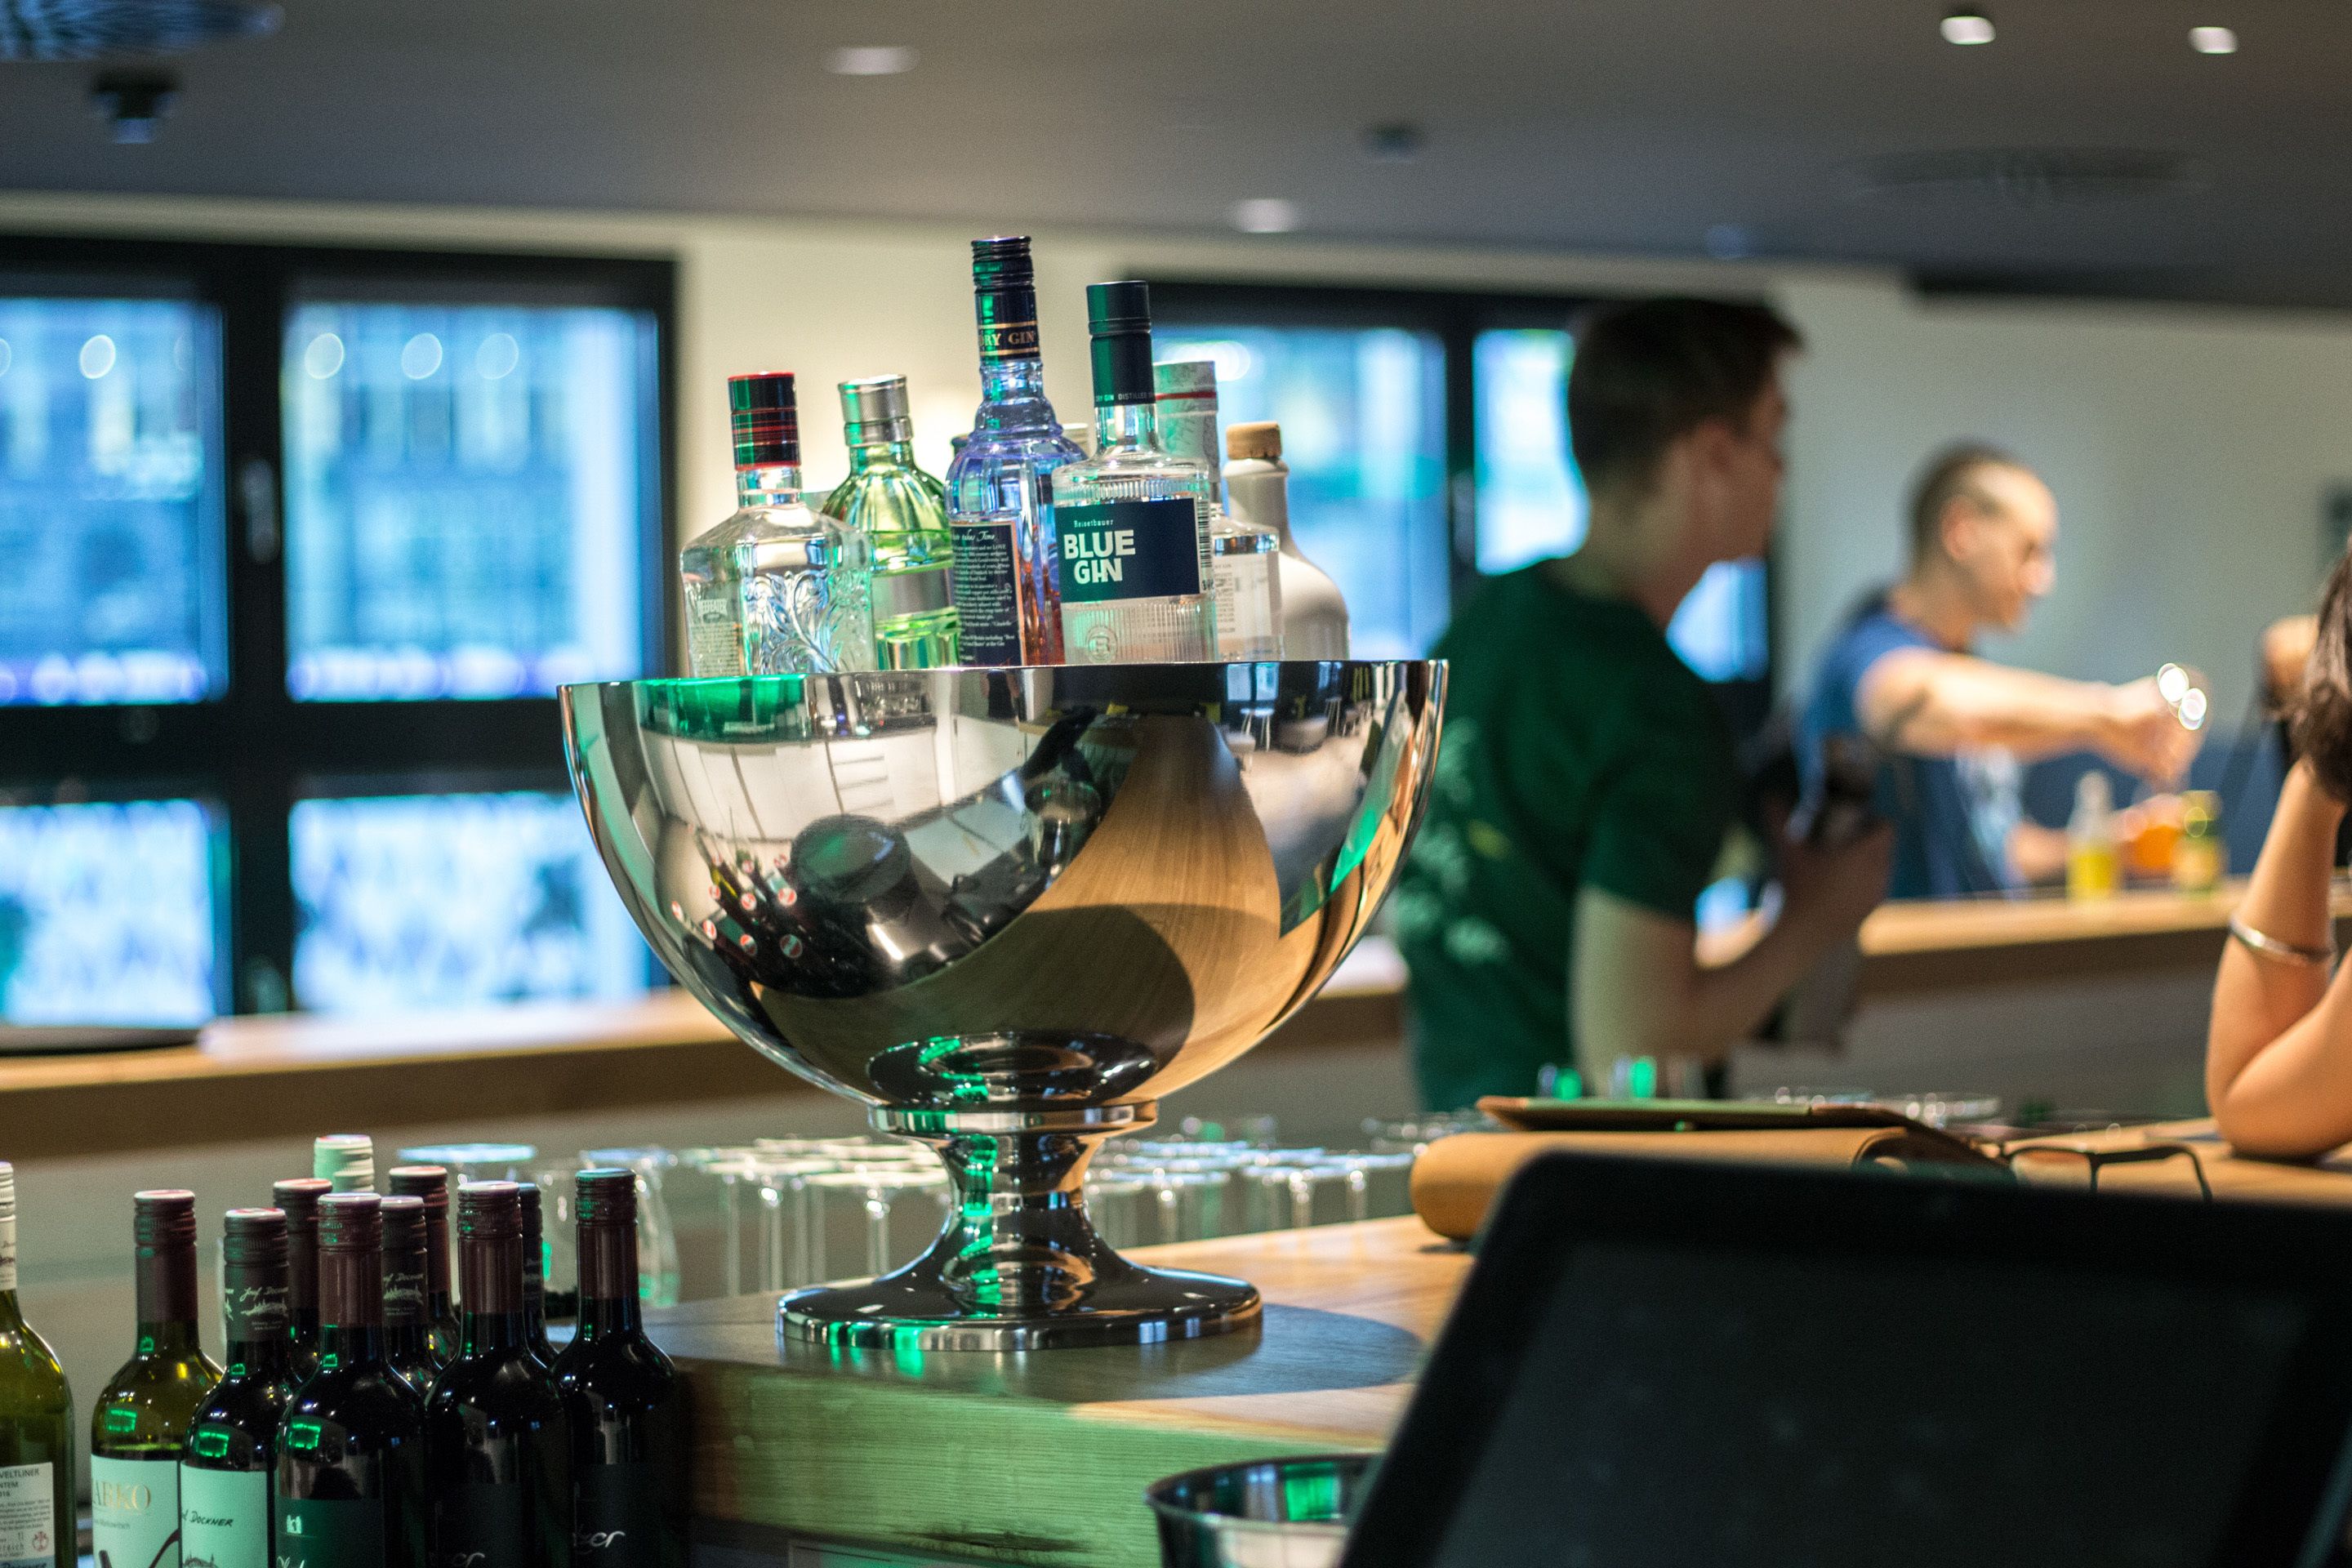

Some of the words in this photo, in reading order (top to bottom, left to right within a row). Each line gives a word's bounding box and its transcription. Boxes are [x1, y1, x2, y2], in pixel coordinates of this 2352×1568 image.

[1008, 331, 1035, 345] GIN
[1063, 529, 1136, 559] BLUE
[1074, 558, 1123, 584] GIN
